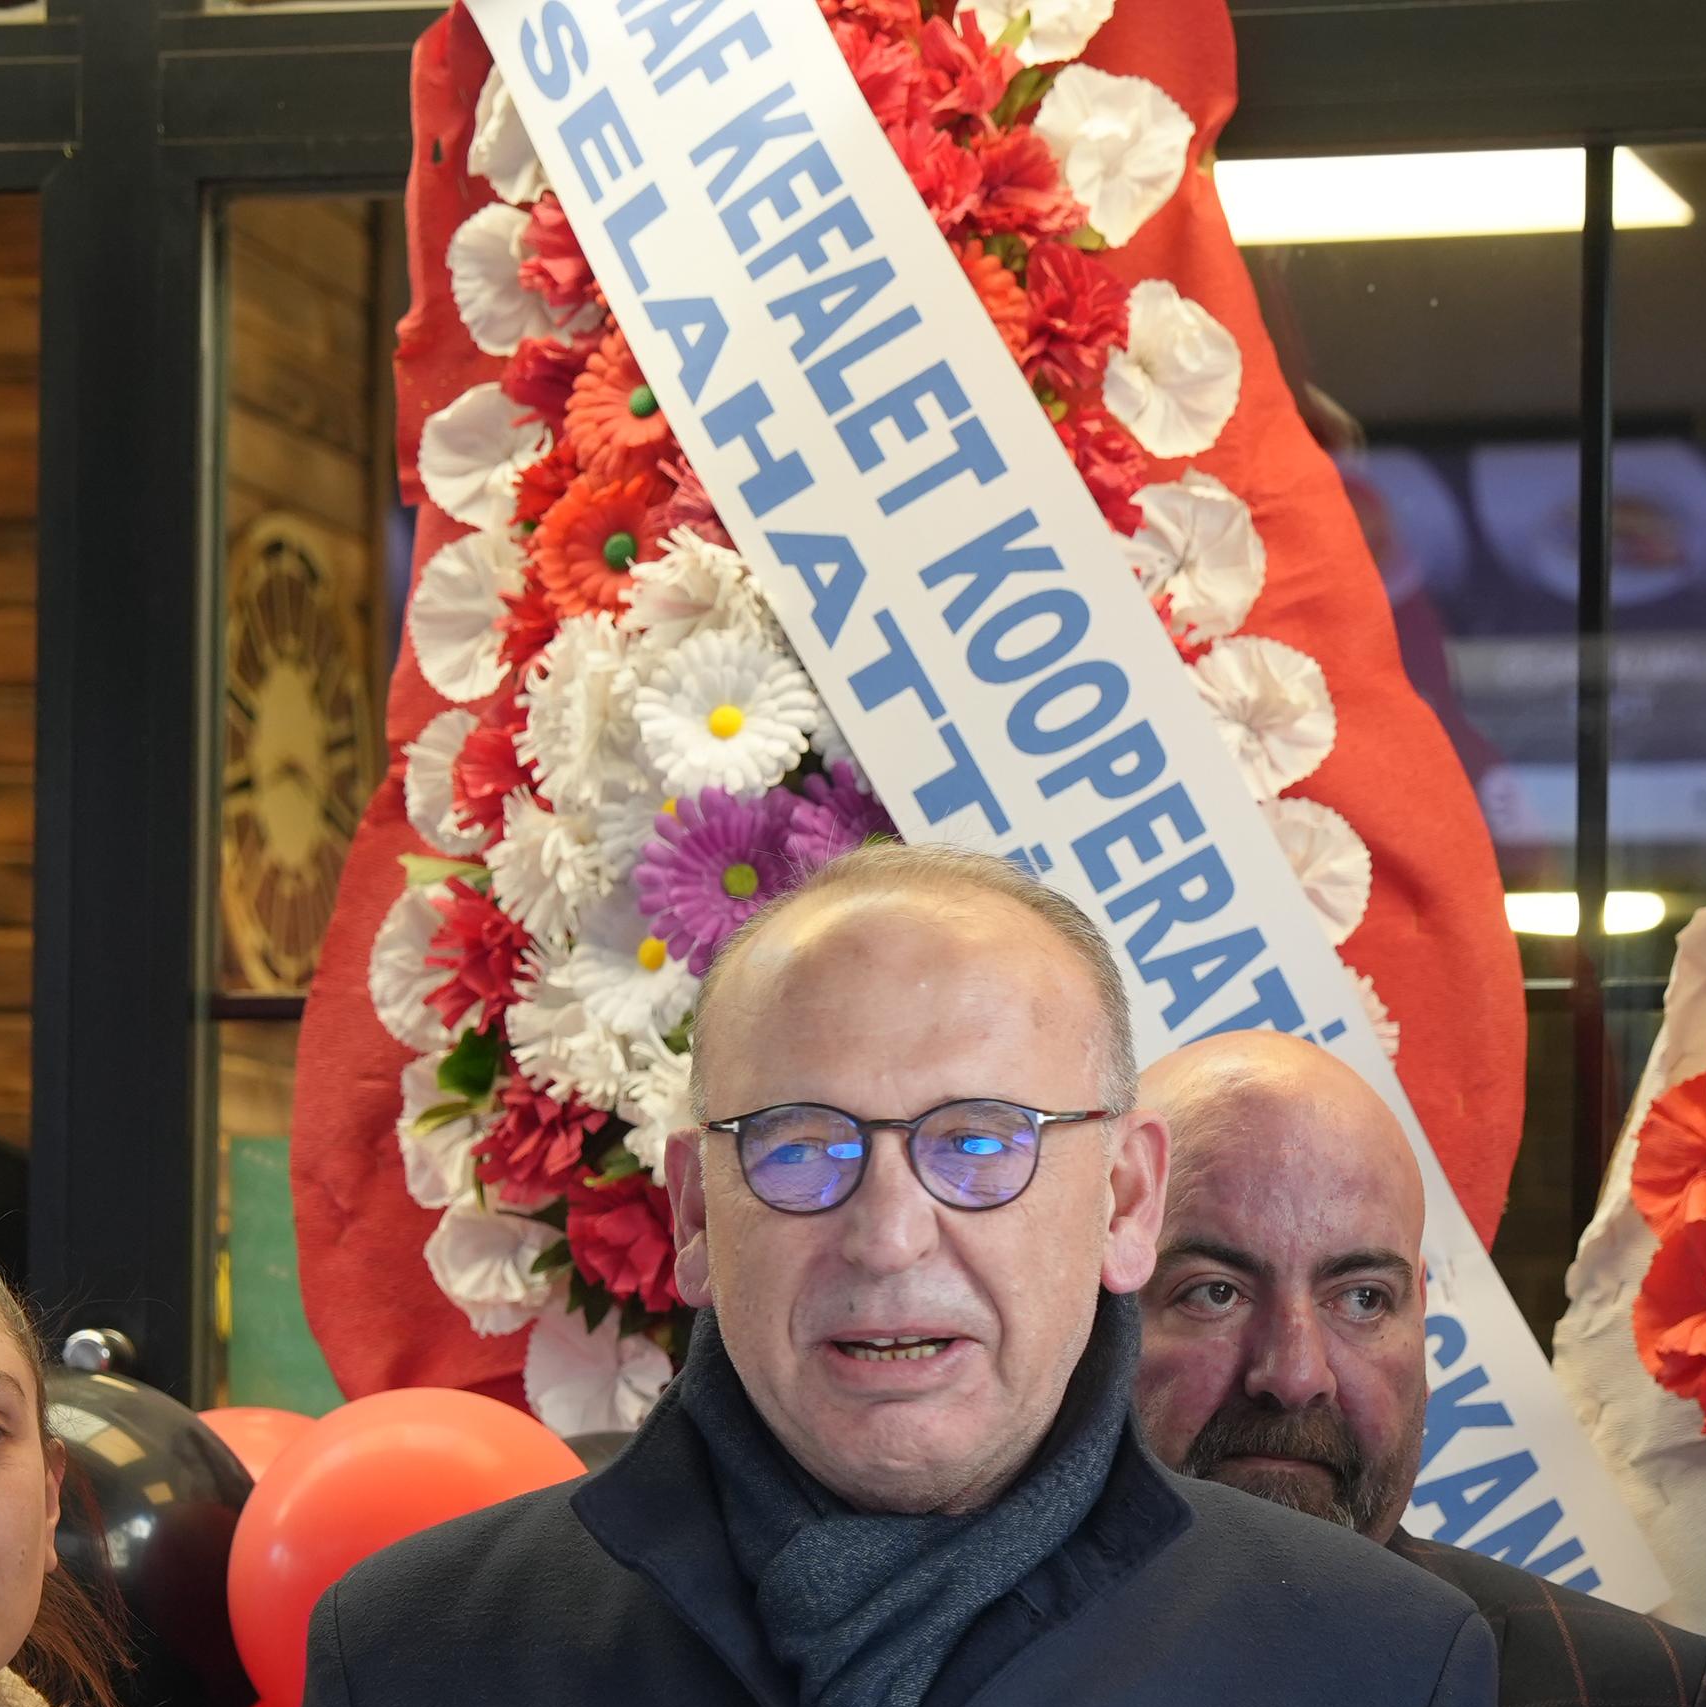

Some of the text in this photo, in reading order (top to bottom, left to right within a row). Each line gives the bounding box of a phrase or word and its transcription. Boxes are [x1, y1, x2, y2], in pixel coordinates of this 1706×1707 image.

[615, 0, 773, 97] AF
[688, 81, 1007, 516] KEFALET
[919, 508, 1348, 1048] KOOPERAT
